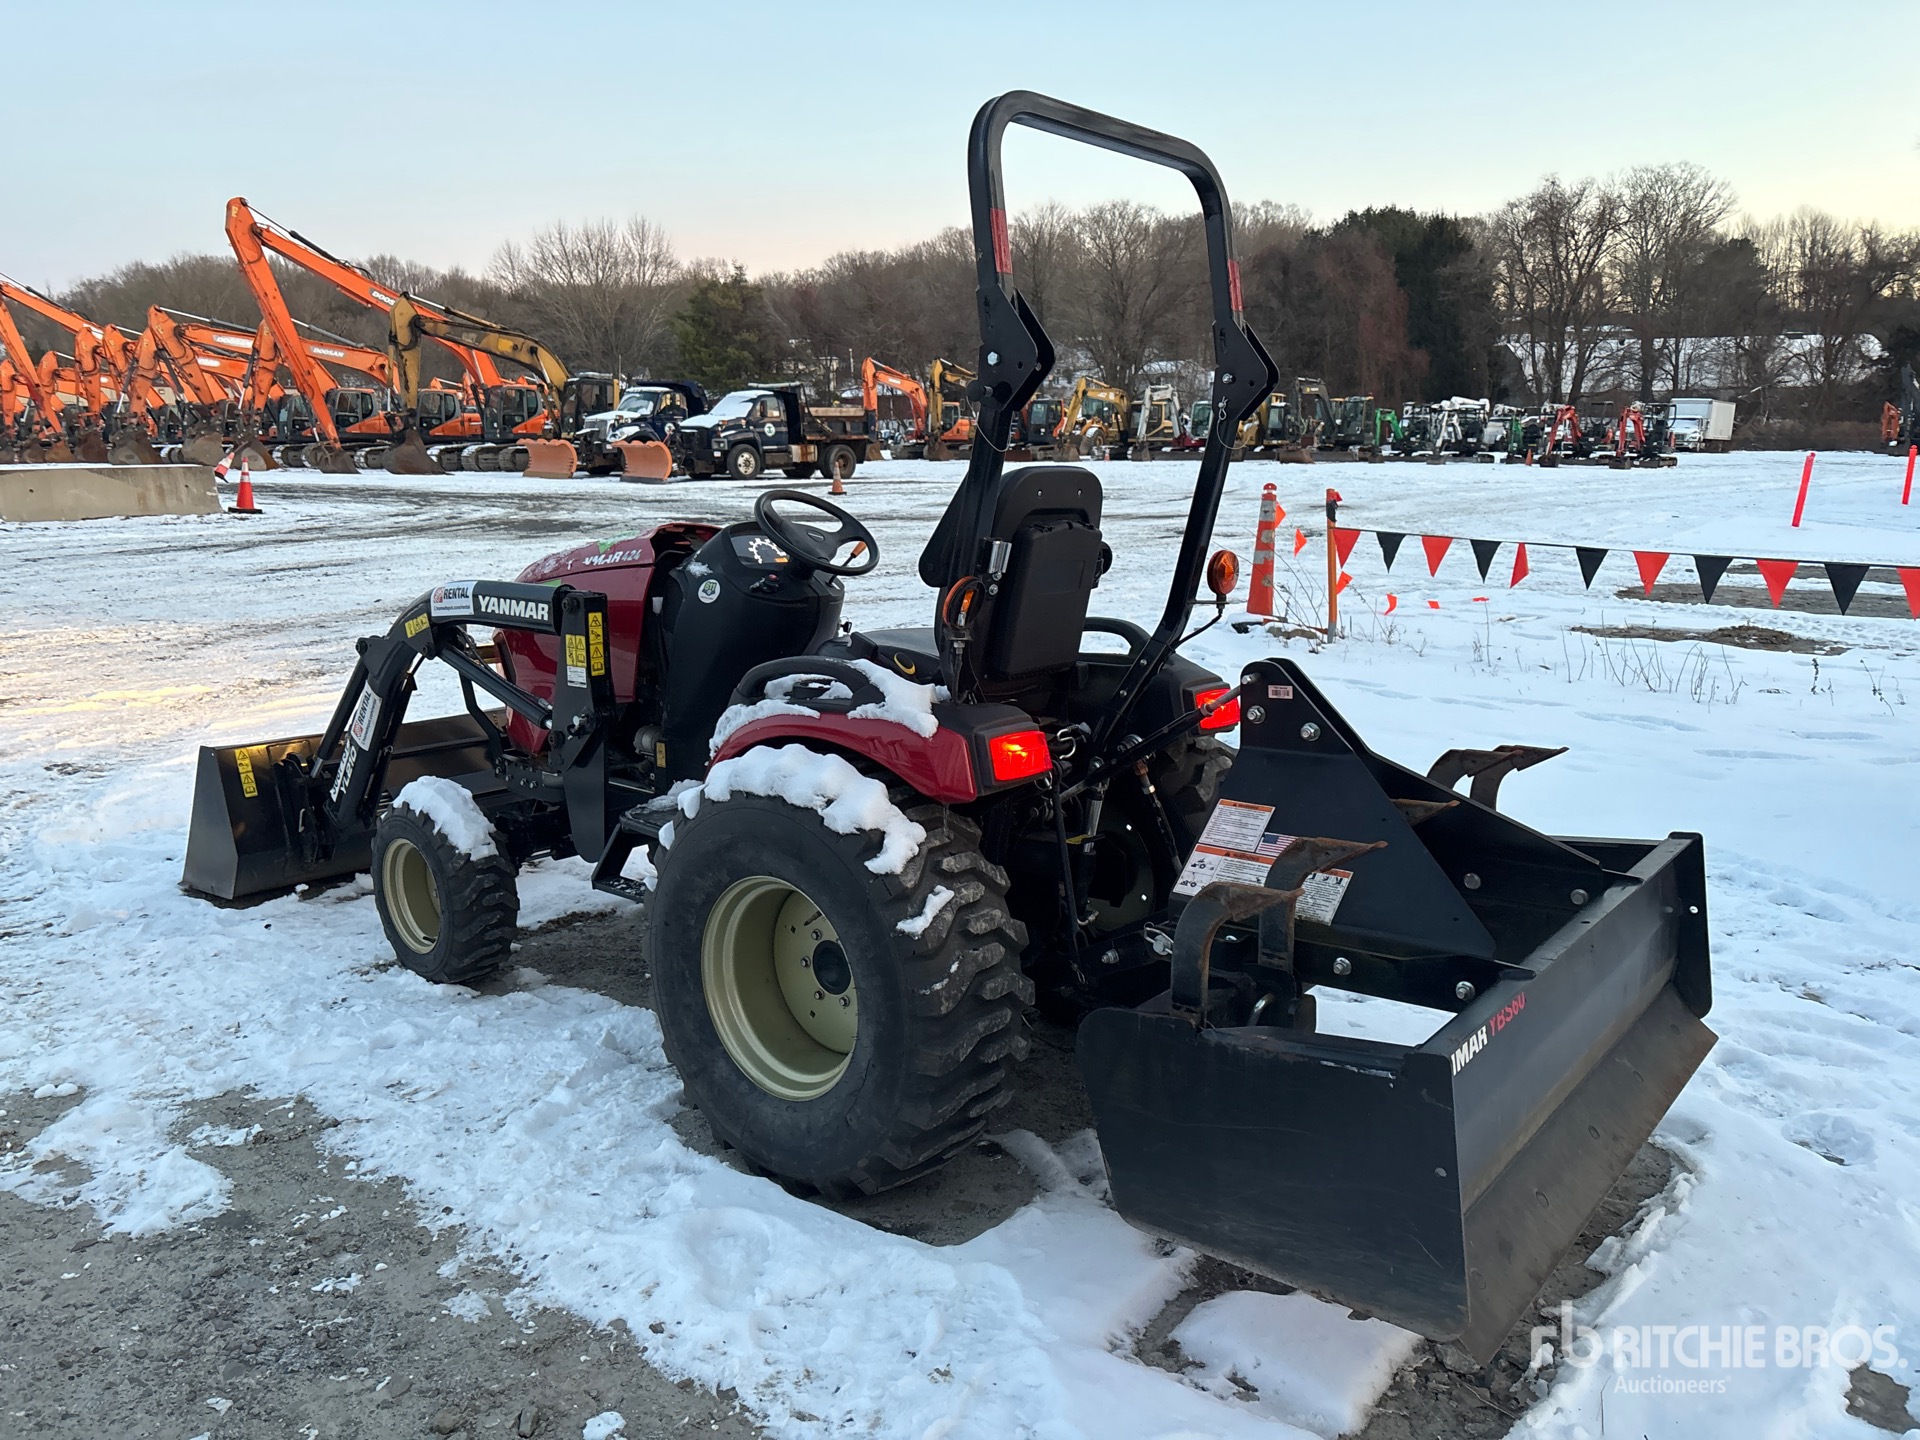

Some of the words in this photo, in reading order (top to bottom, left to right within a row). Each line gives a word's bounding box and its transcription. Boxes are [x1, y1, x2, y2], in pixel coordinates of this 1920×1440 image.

[371, 290, 396, 306] DOOS
[313, 347, 344, 358] DOOSAN
[622, 549, 643, 562] 424
[443, 587, 470, 600] RENTAL
[478, 595, 549, 621] YANMAR
[357, 691, 372, 726] RENTAL
[340, 745, 357, 794] YL210
